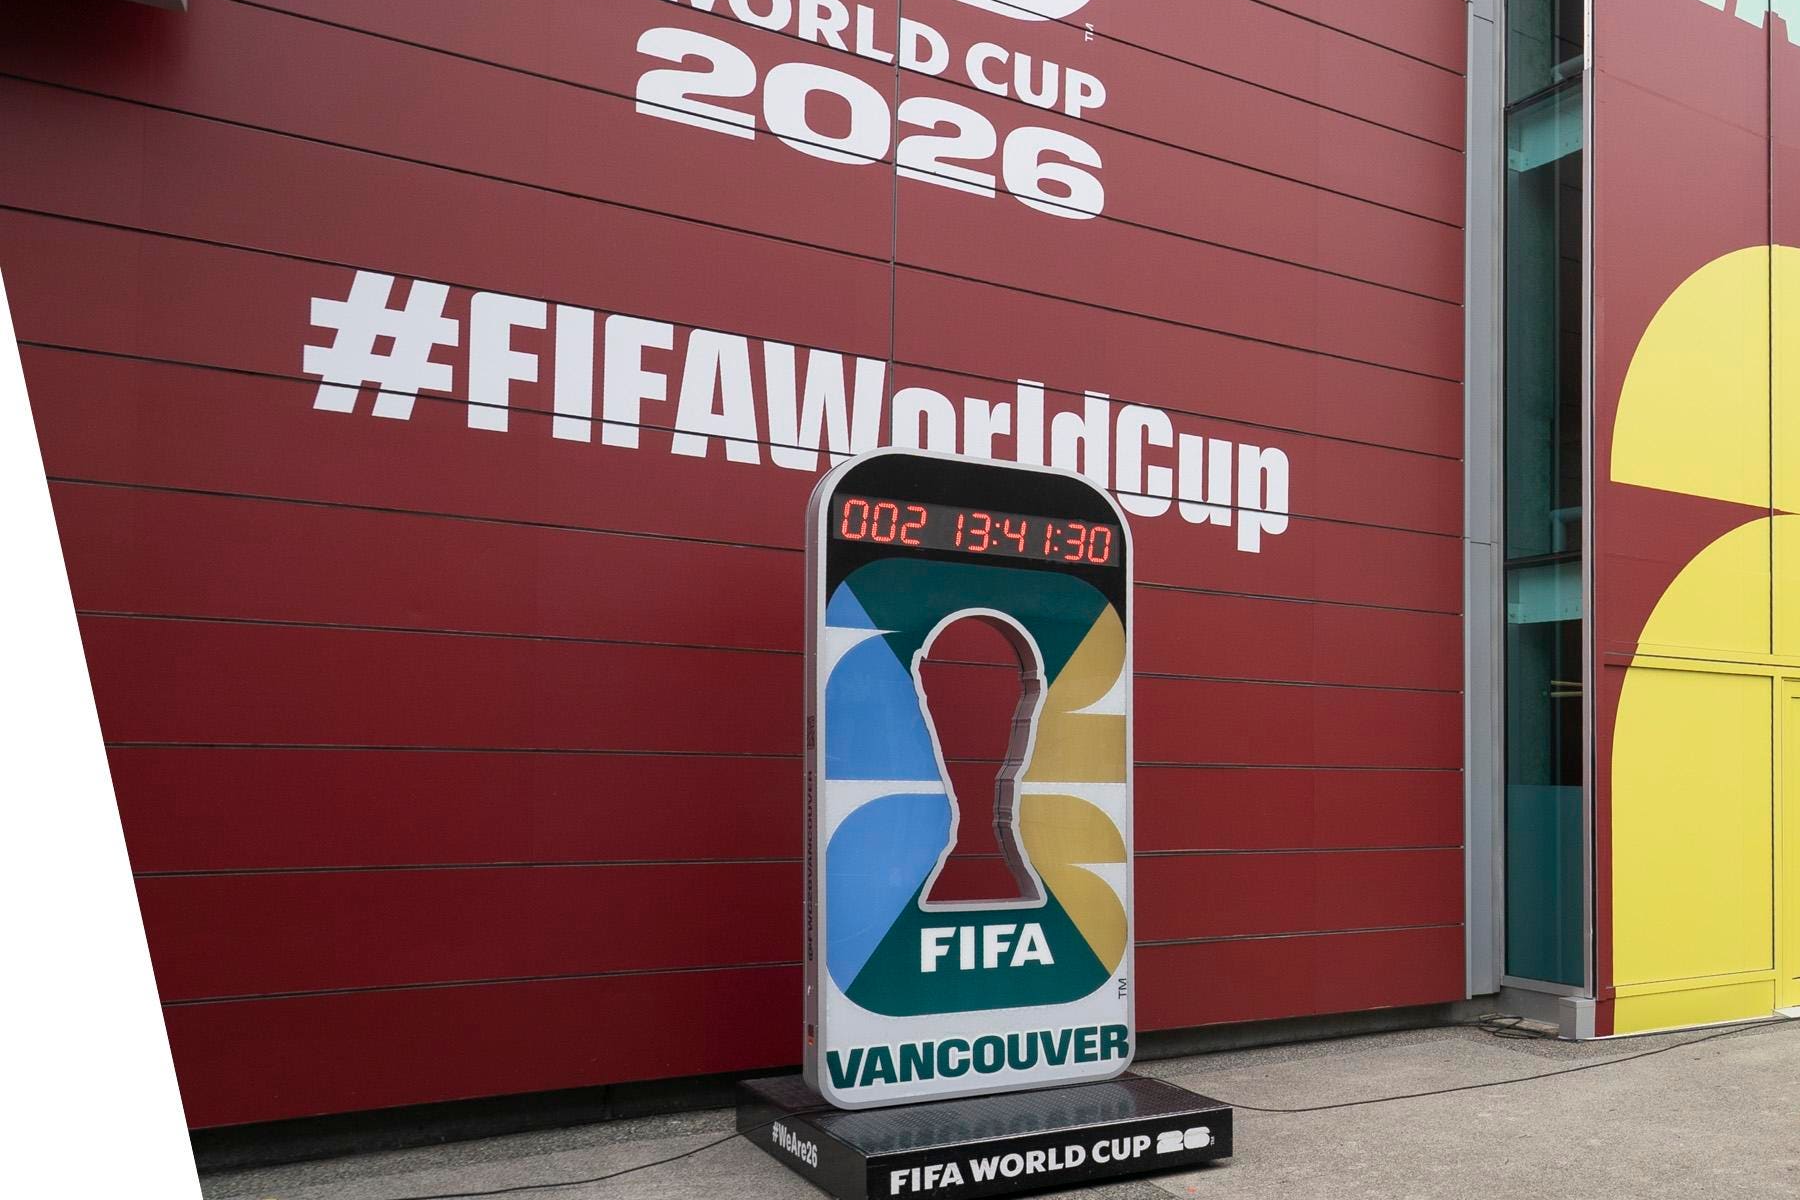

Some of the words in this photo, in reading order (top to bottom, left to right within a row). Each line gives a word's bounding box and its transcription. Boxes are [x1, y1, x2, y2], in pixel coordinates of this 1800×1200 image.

[964, 41, 1107, 118] CUP
[635, 27, 1105, 220] 2026
[302, 270, 1291, 553] #FIFAWorldCup
[840, 498, 928, 545] 002
[954, 511, 1112, 563] 13:41:30
[919, 922, 1055, 973] FIFA
[826, 1023, 1129, 1090] VANCOUVER
[772, 1120, 818, 1169] #WeAre26
[890, 1161, 965, 1196] FIFA
[969, 1145, 1084, 1188] WORLD
[1092, 1135, 1152, 1166] CUP
[1156, 1126, 1211, 1155] 26
